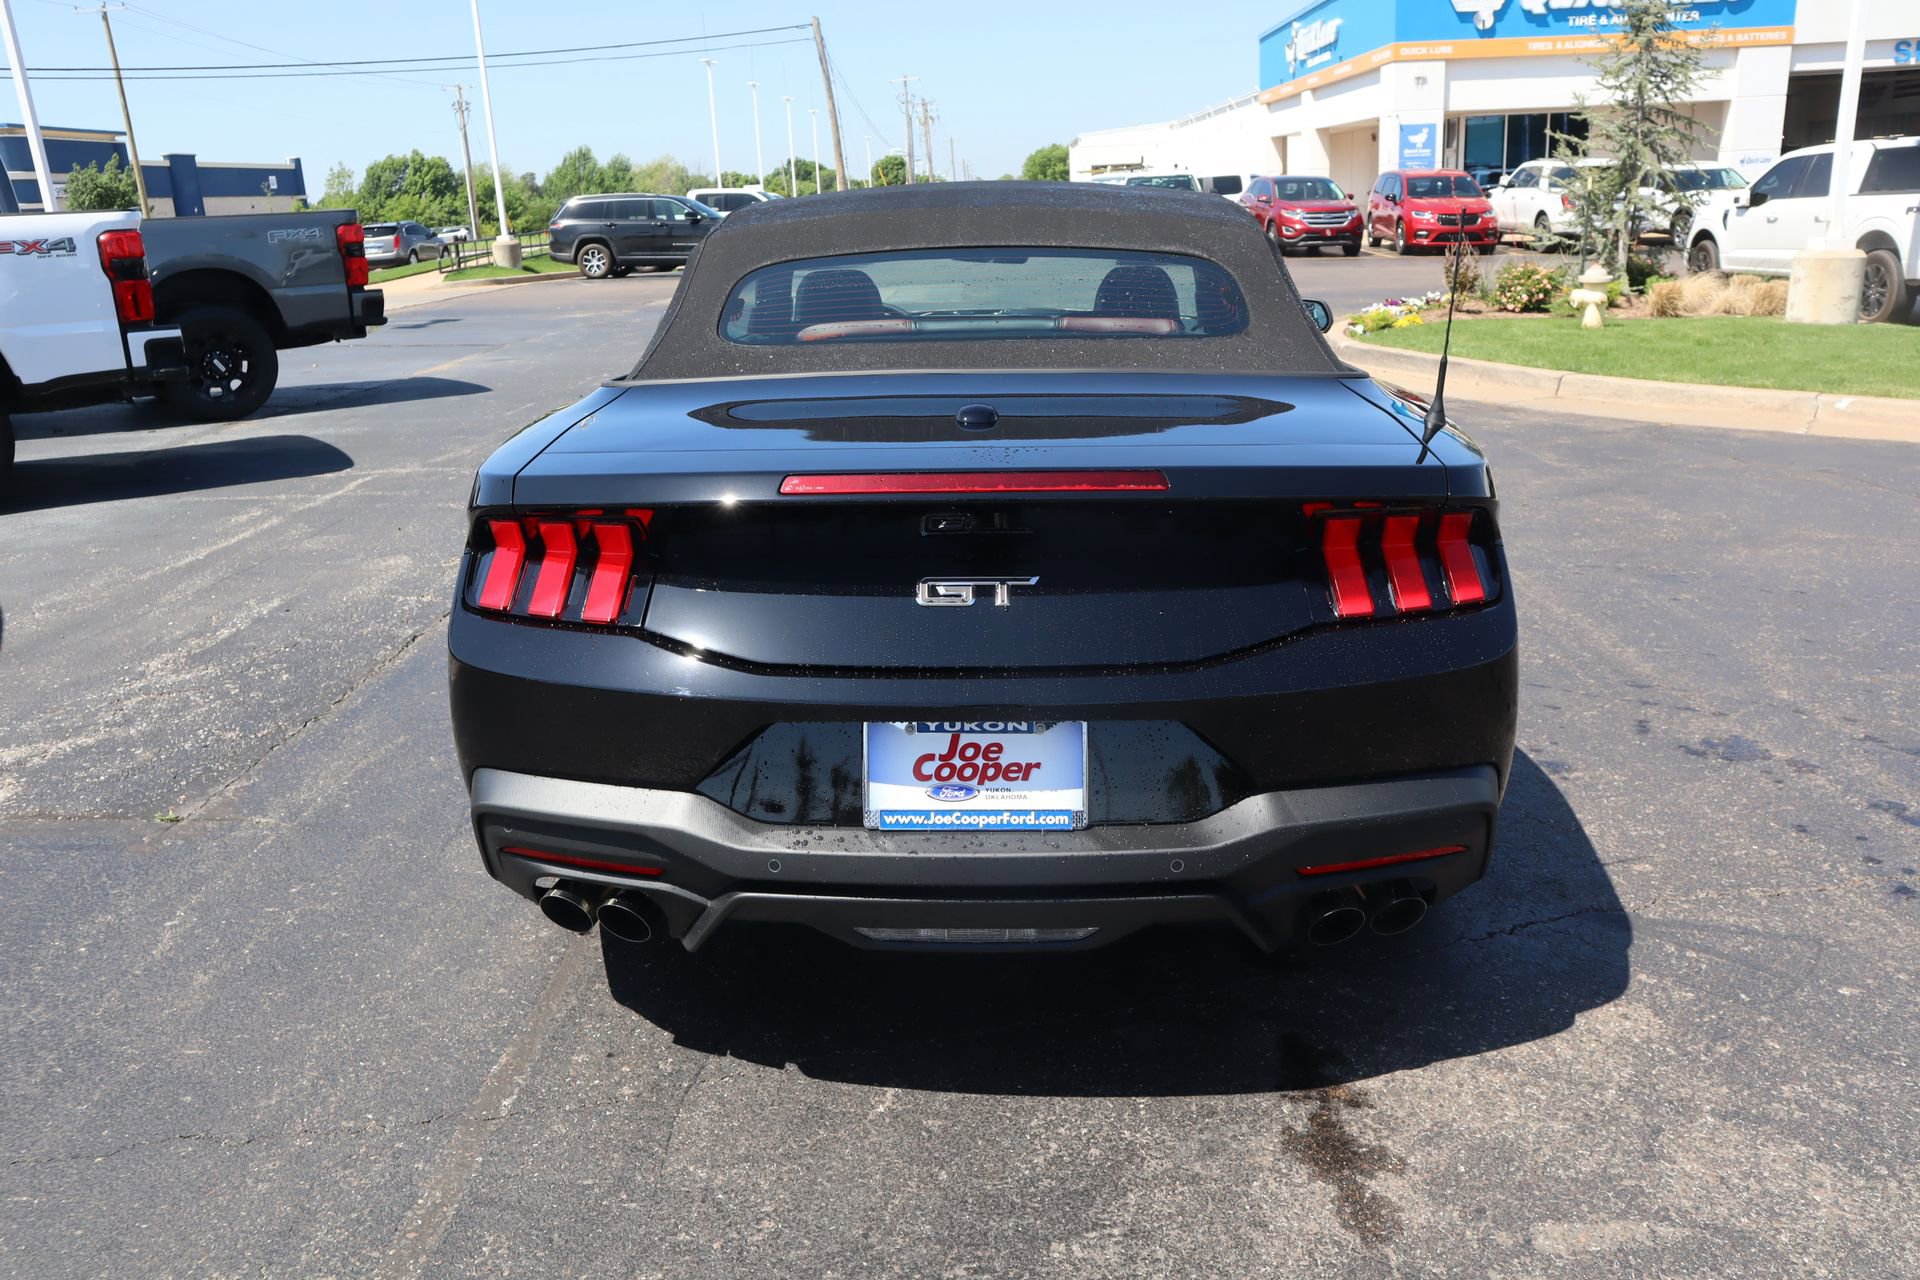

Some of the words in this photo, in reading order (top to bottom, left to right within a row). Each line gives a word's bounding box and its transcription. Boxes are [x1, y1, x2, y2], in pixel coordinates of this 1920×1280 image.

[1568, 14, 1597, 27] TIRE
[1599, 14, 1608, 26] &
[1736, 31, 1787, 41] BATTERIES
[1400, 47, 1428, 56] QUICK
[1430, 45, 1454, 54] LUBE
[1528, 42, 1553, 51] TIRES
[267, 227, 323, 243] FX4
[916, 576, 1040, 606] GT
[923, 722, 1028, 731] YUKON
[938, 733, 1004, 762] Joe
[912, 753, 1041, 786] Cooper
[939, 786, 967, 799] Ford
[883, 811, 1069, 828] www.JoeCooperFord.com
